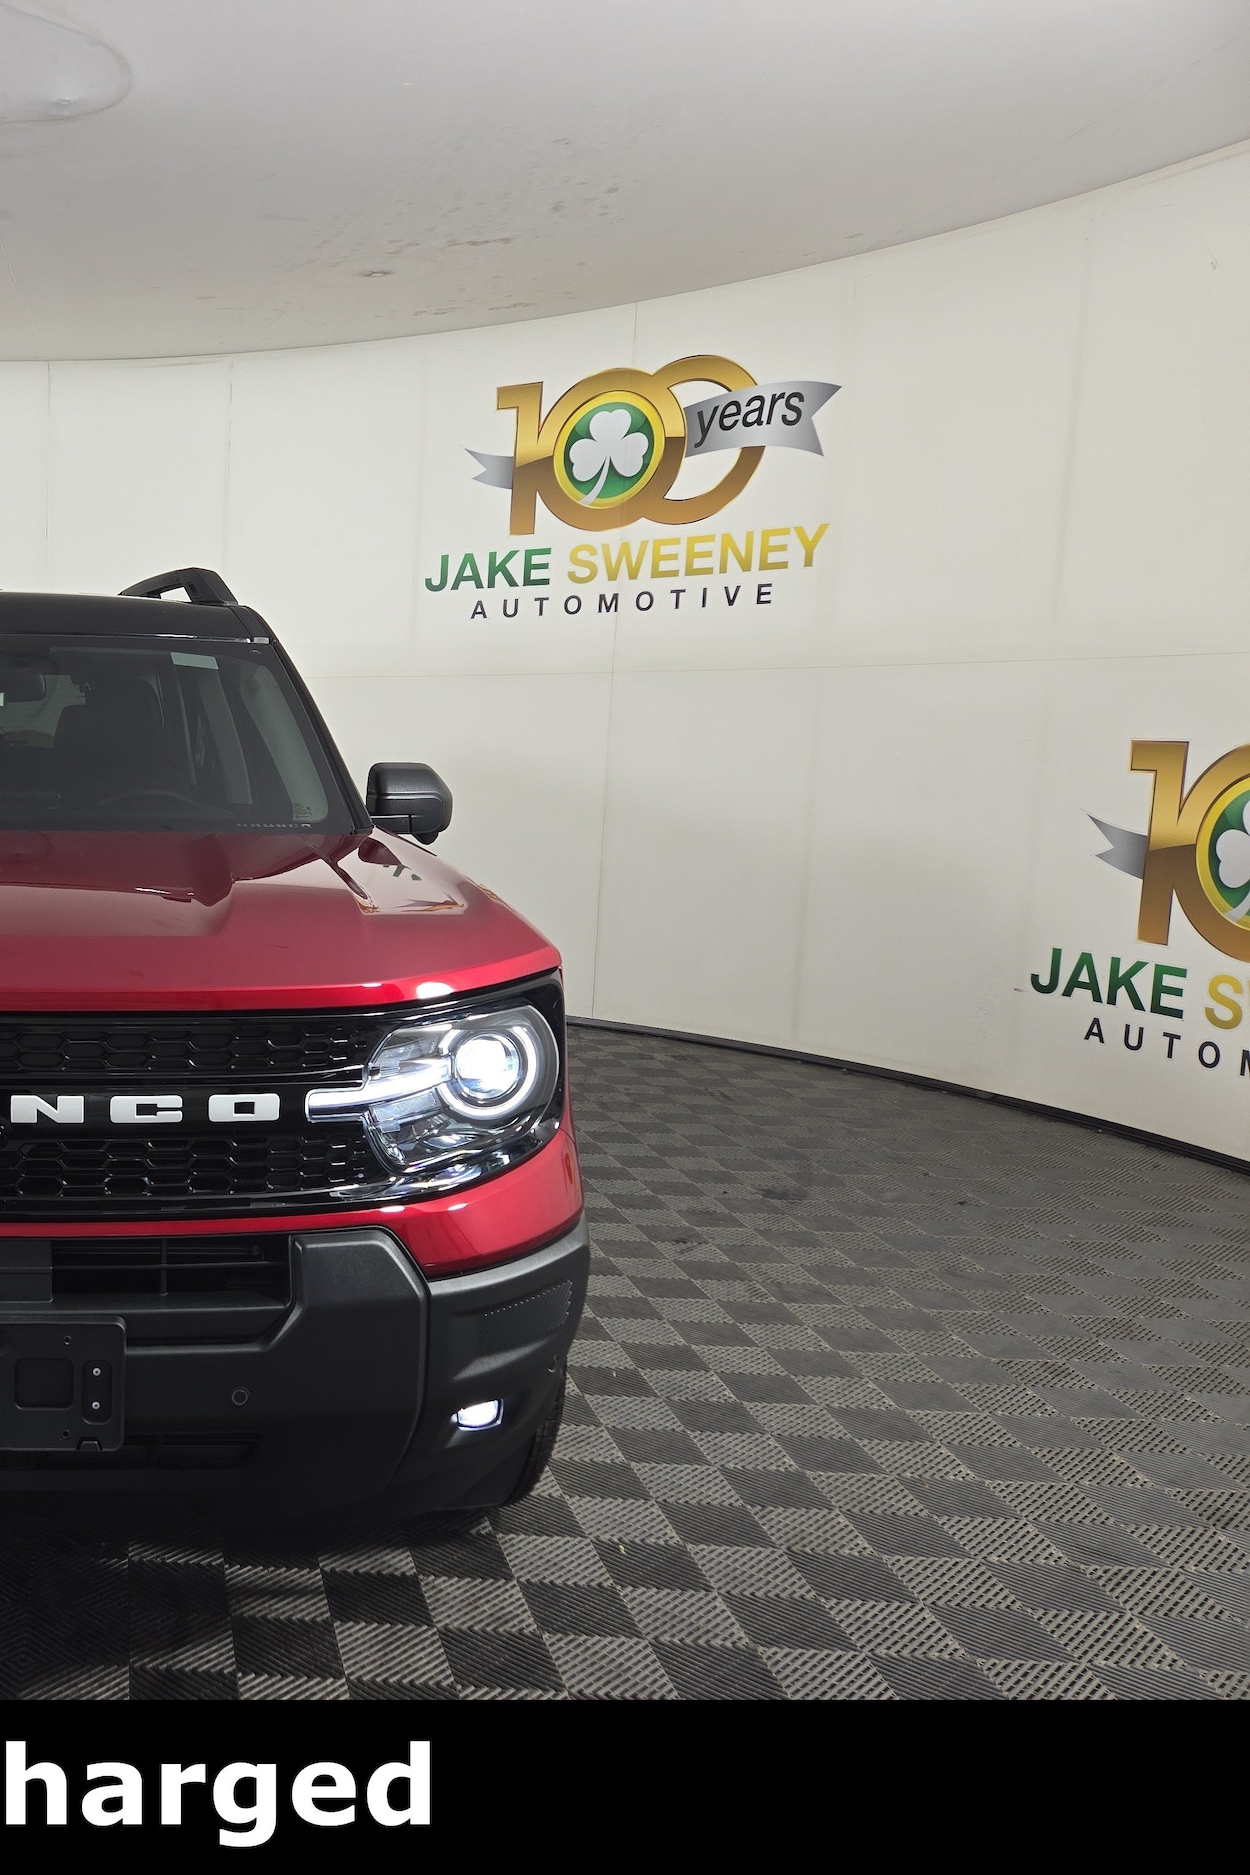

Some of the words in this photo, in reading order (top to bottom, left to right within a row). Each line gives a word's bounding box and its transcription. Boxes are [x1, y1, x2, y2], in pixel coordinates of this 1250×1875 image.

[693, 391, 805, 448] years
[424, 547, 552, 592] JAKE
[567, 523, 830, 584] SWEENEY
[470, 583, 773, 620] AUTOMOTIVE
[1030, 947, 1188, 1020] JAKE
